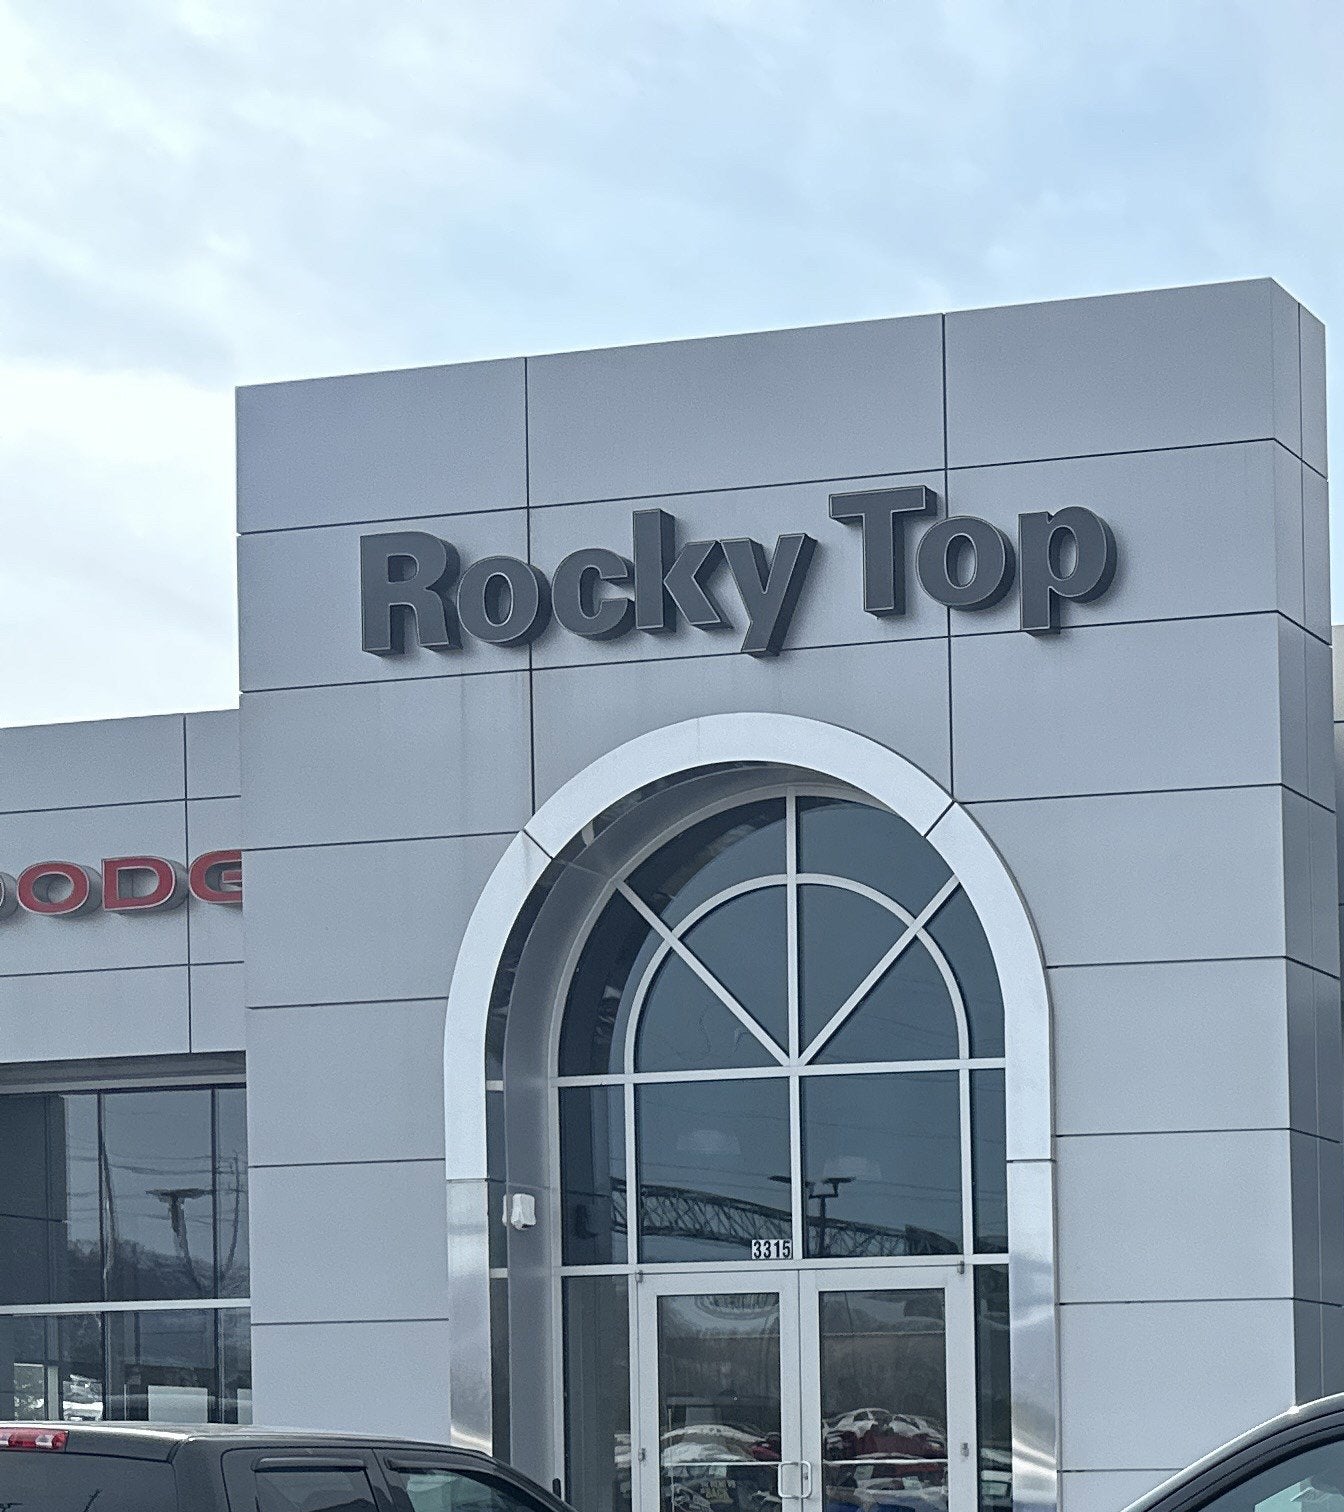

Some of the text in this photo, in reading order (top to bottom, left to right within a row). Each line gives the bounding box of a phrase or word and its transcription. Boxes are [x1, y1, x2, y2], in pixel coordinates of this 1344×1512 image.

[360, 485, 1117, 657] Rocky Top
[0, 849, 243, 916] ODG
[752, 1240, 792, 1259] 3315
